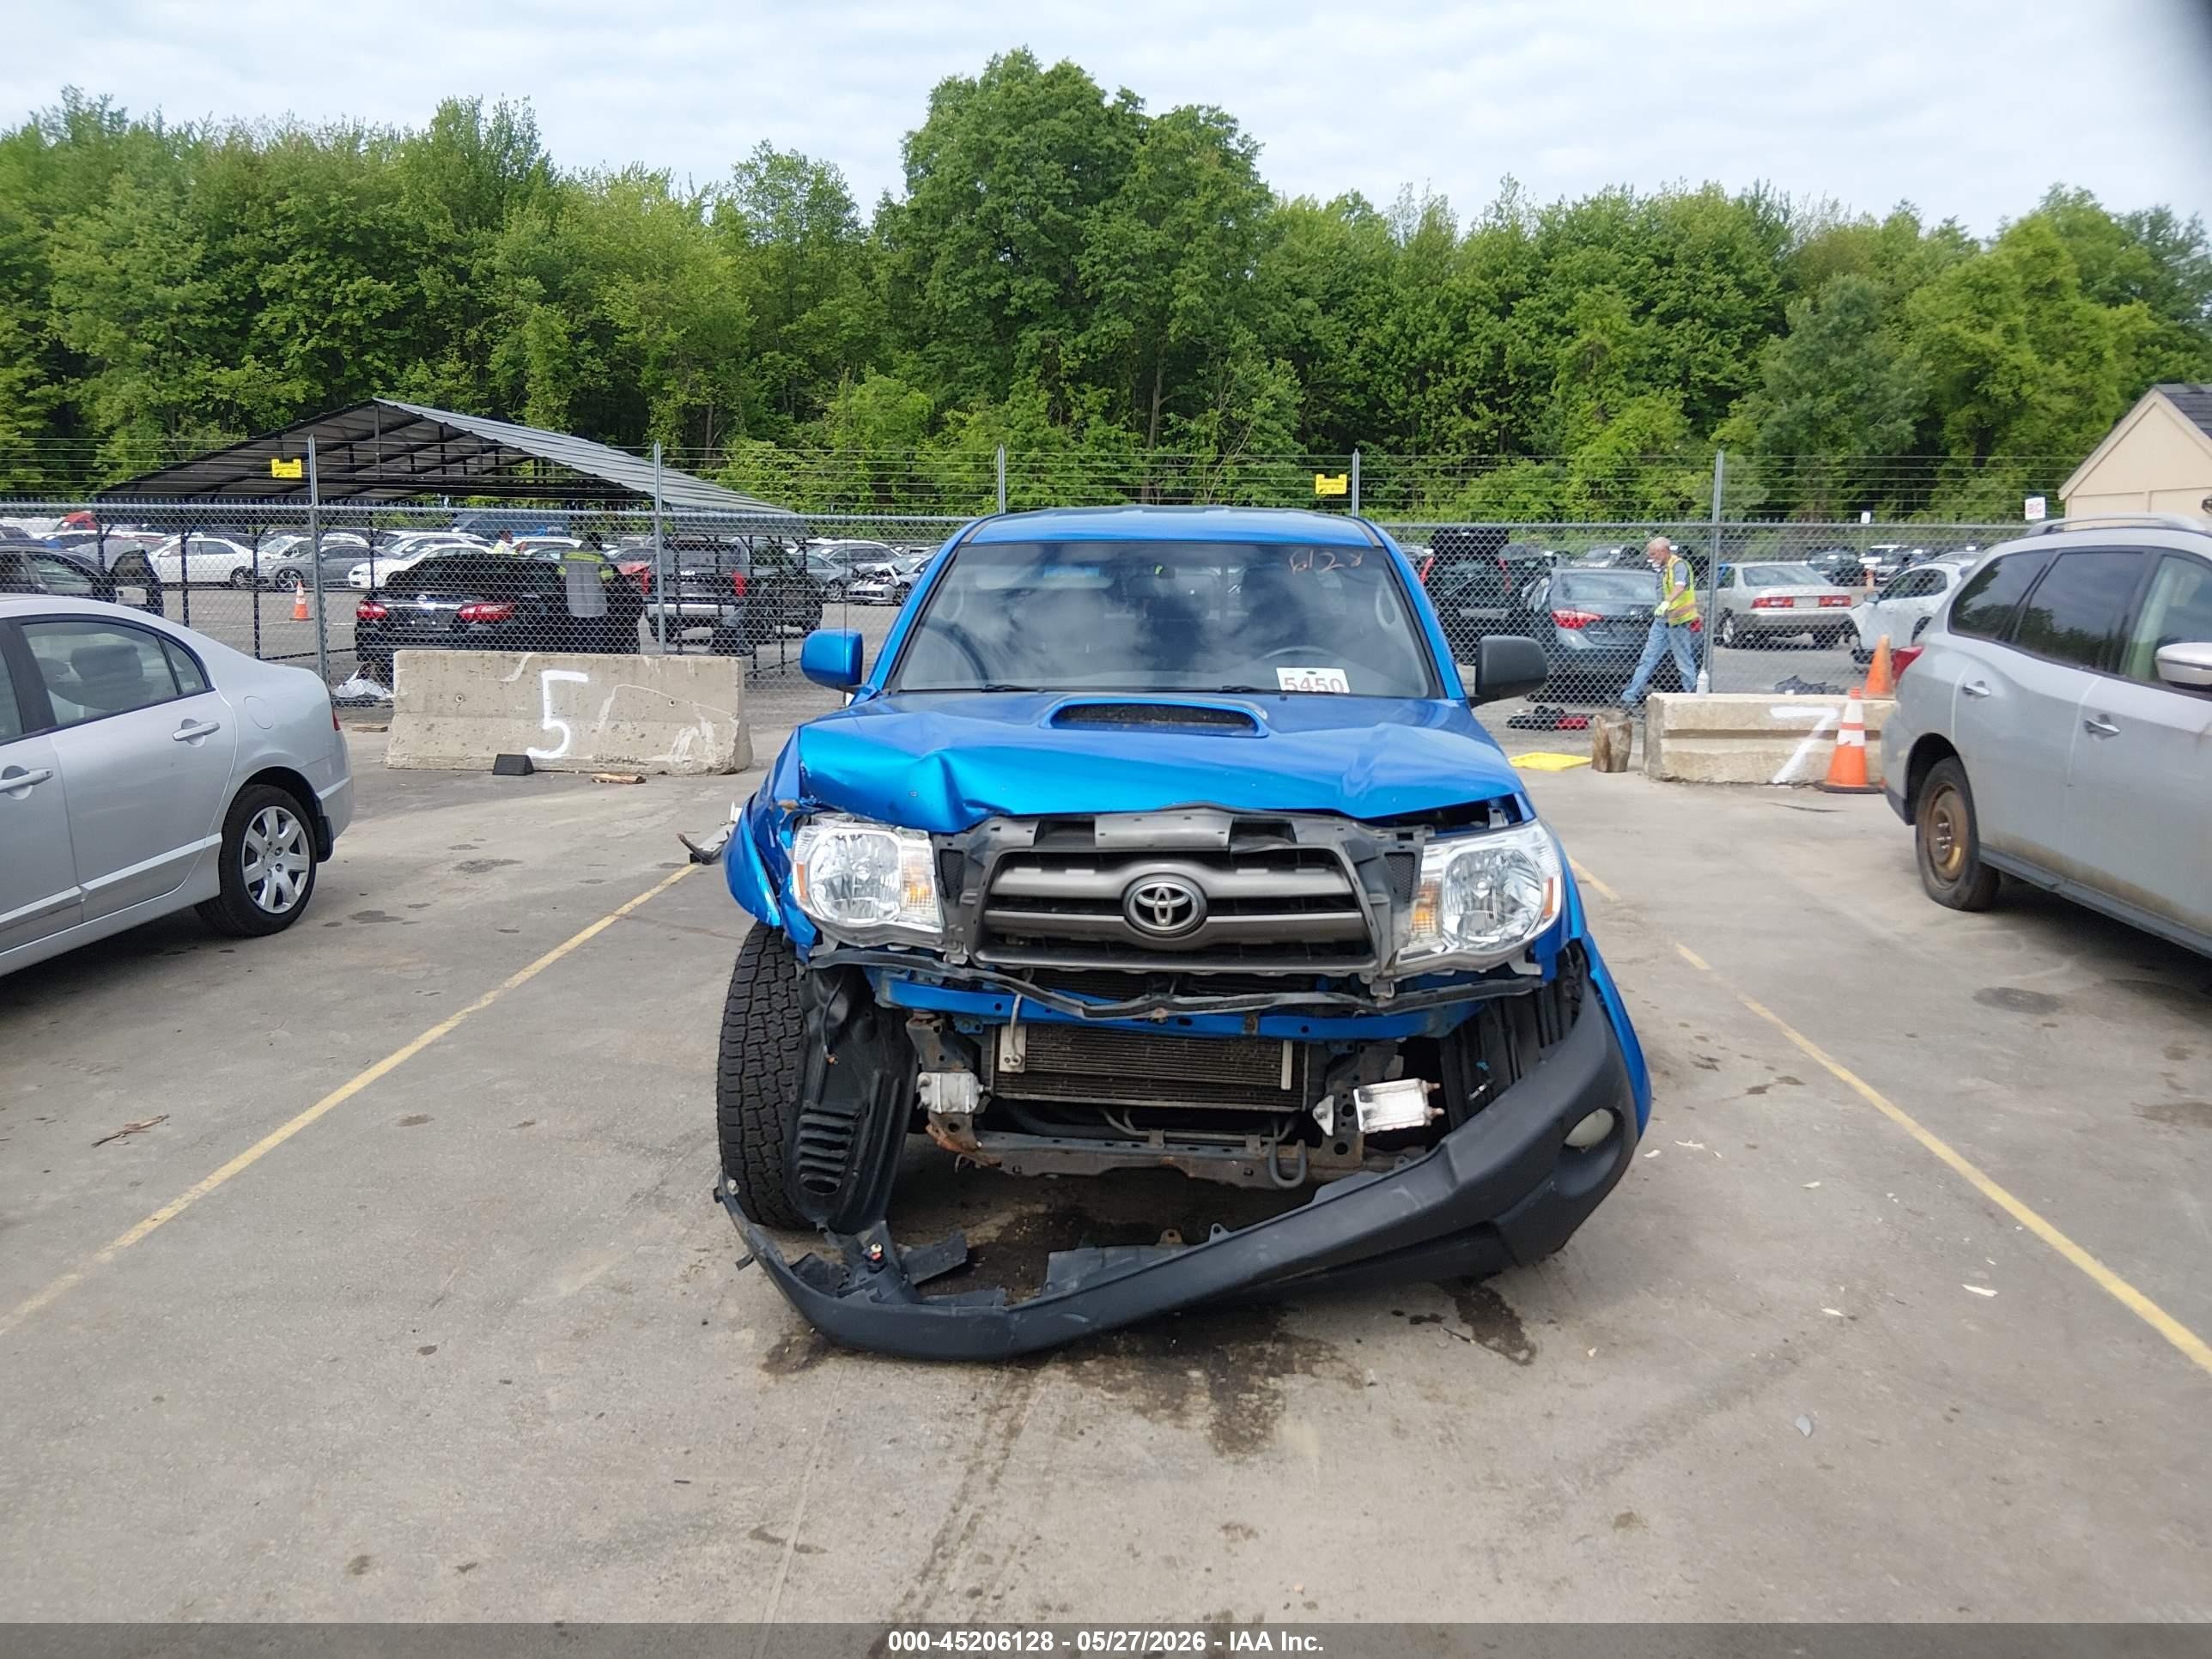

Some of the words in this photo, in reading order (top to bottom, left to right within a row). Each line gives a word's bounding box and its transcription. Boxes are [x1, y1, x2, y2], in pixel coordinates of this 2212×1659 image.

[526, 669, 589, 759] 5
[1284, 677, 1345, 693] 5450
[1770, 706, 1841, 784] 7
